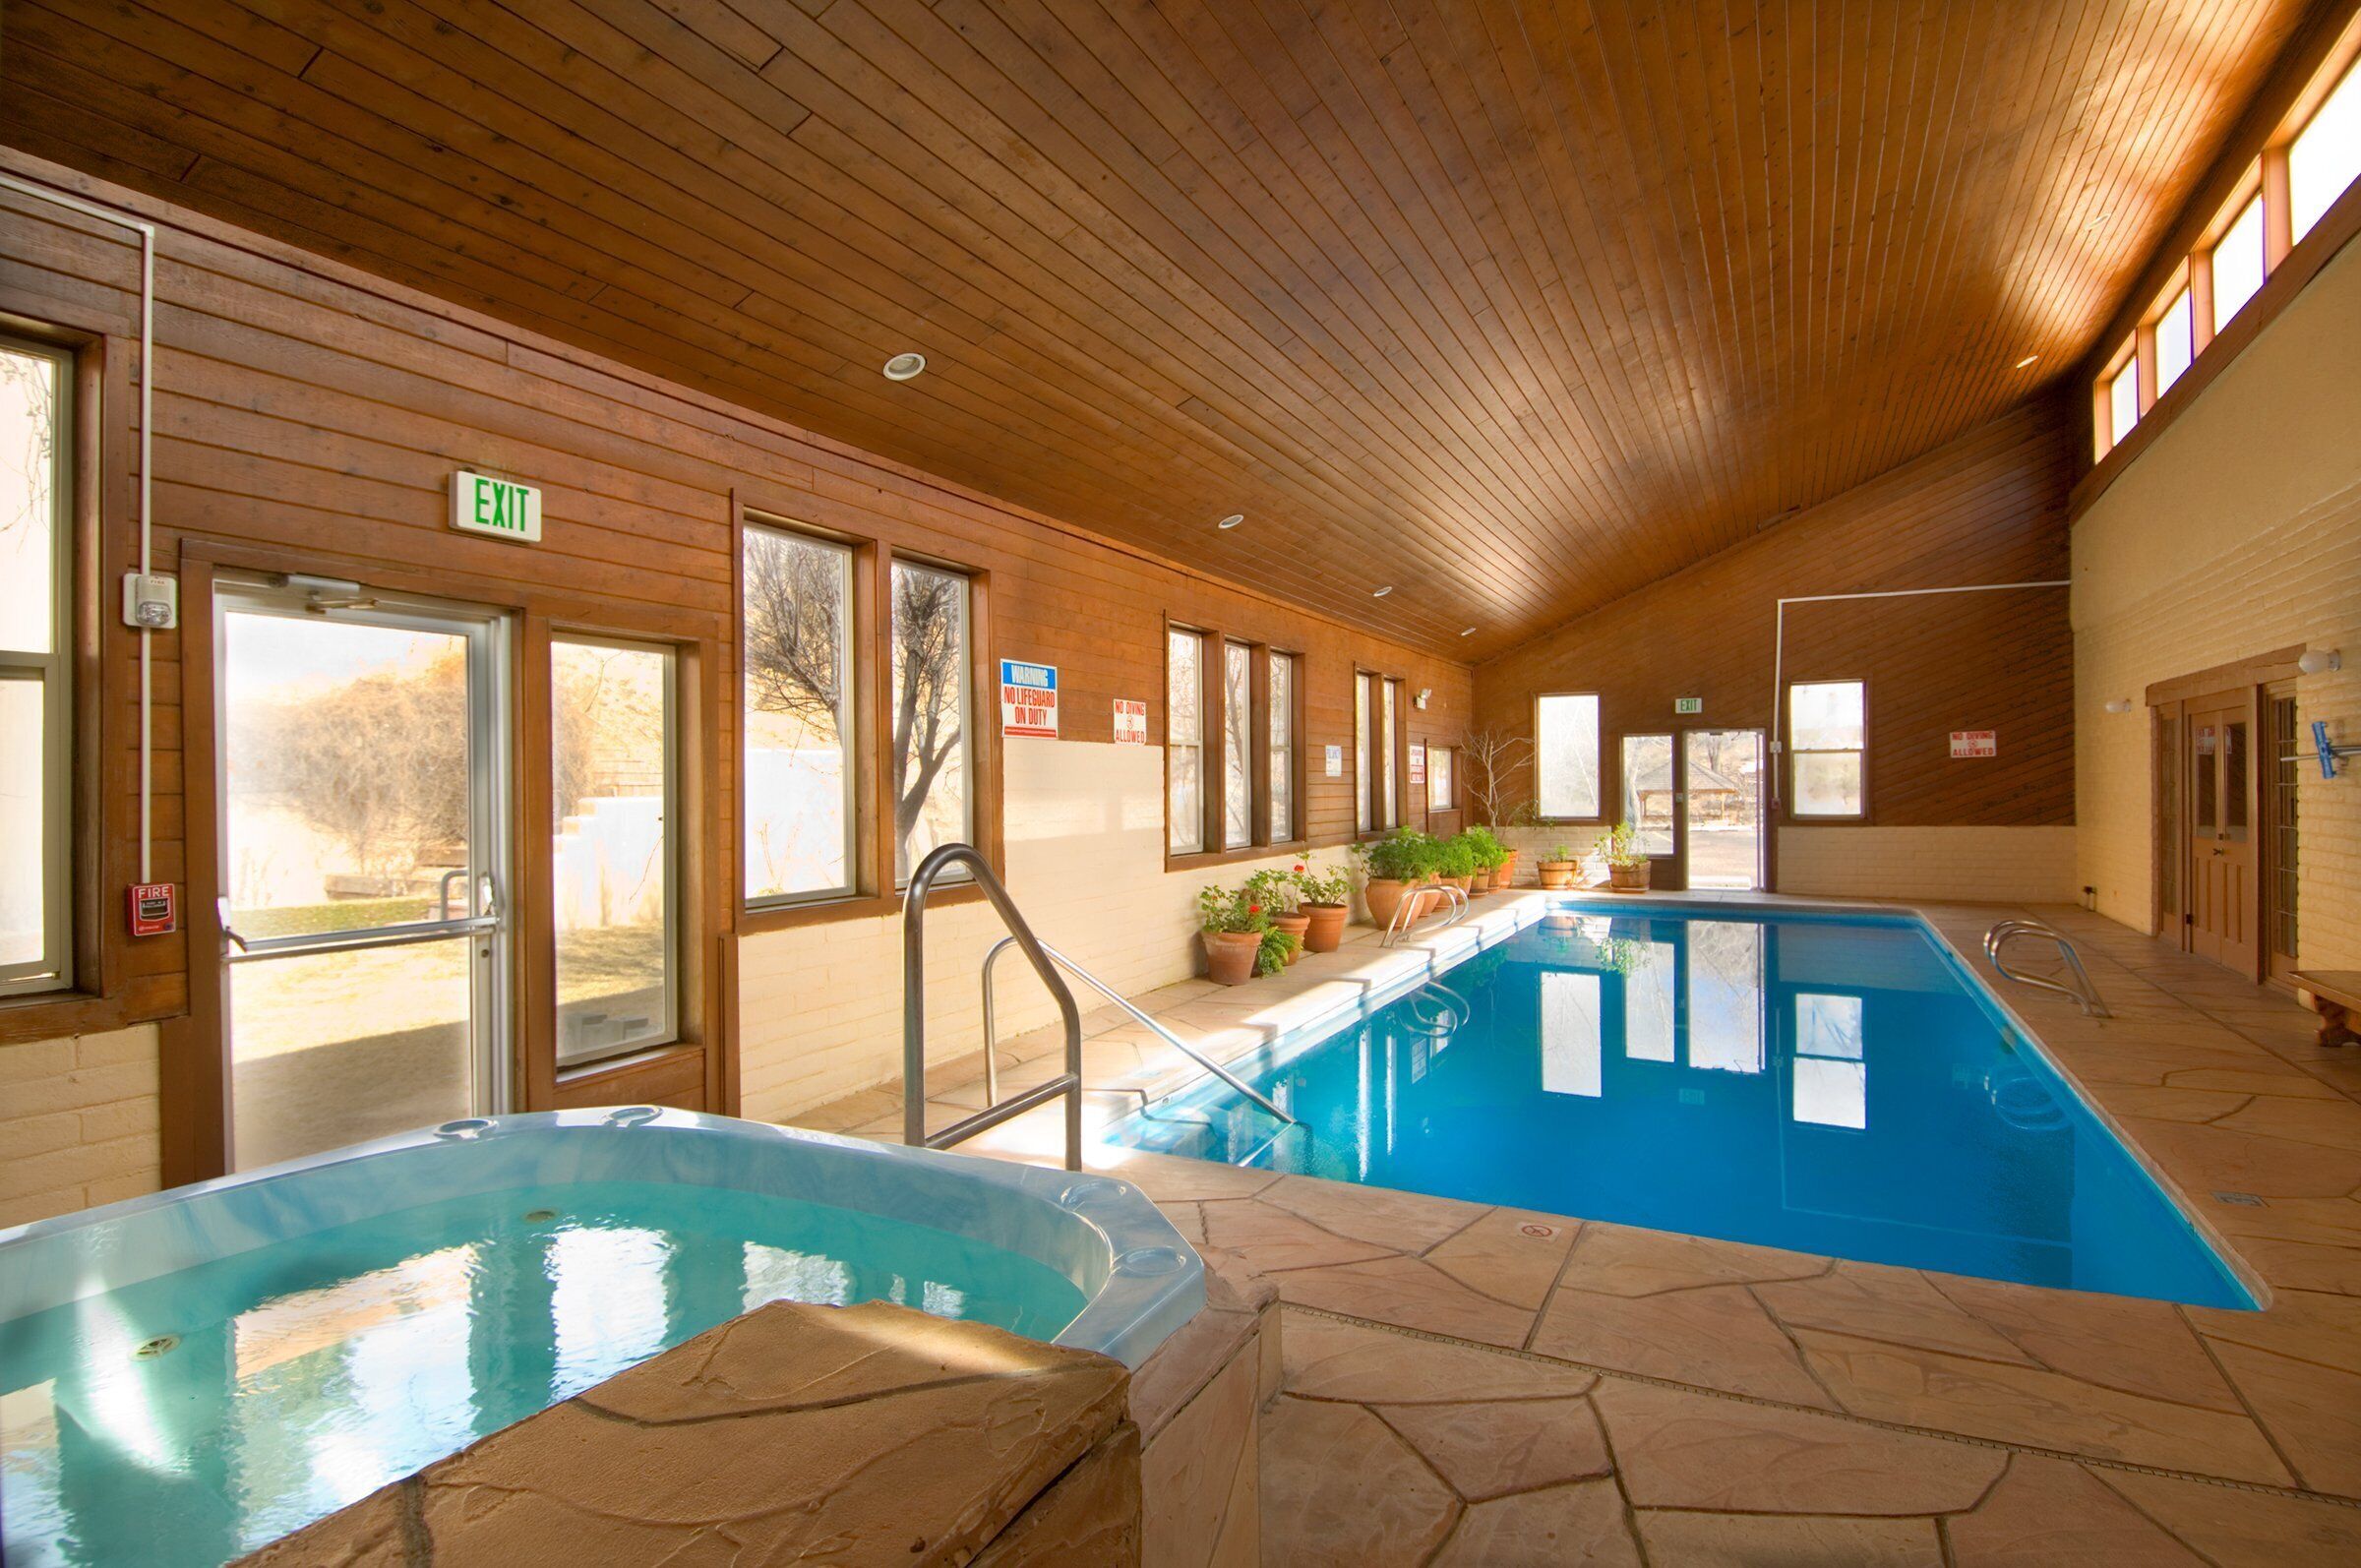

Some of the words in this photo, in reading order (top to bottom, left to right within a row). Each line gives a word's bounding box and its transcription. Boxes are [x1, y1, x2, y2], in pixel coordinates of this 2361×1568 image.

[475, 478, 529, 532] EXIT
[1011, 664, 1049, 688] WARNING
[1004, 686, 1015, 704] NO
[1017, 688, 1056, 707] LIFEGUARD
[1680, 698, 1697, 711] EXIT
[1015, 706, 1026, 724] ON
[1028, 708, 1048, 726] DUTY
[1116, 700, 1123, 714] NO
[1126, 701, 1145, 716] DIVING
[1116, 729, 1145, 744] ALLOWED
[1952, 731, 1963, 741] NO
[1966, 731, 1994, 740] DIVING
[138, 886, 169, 899] FIRE
